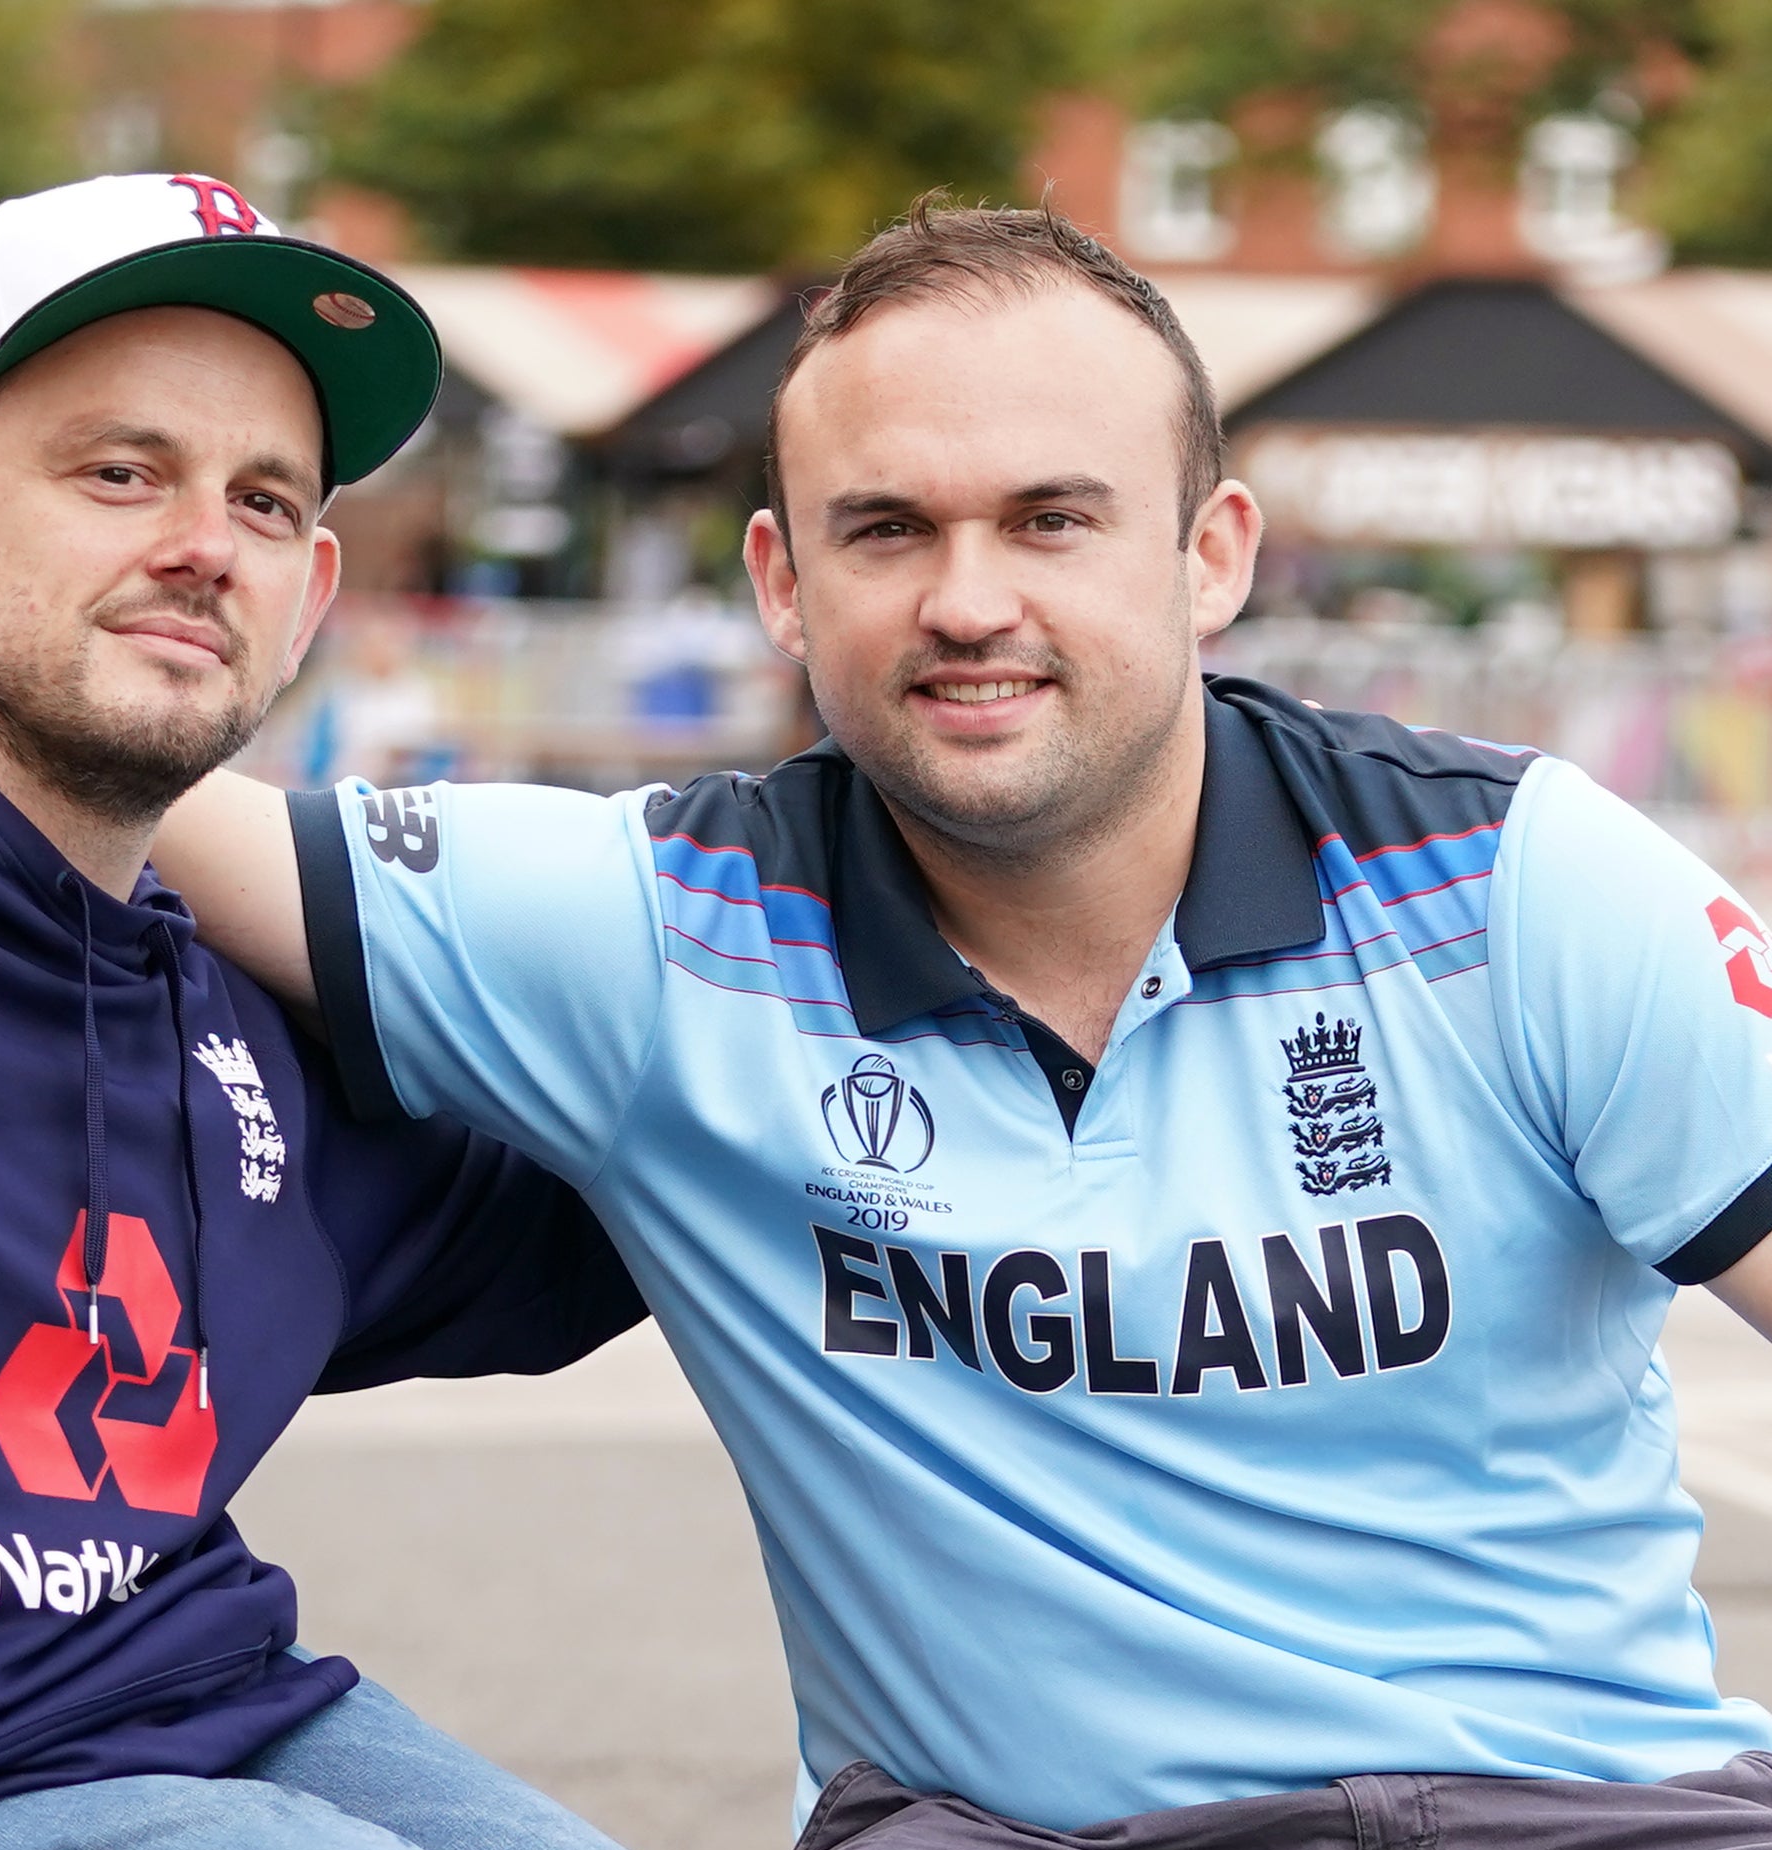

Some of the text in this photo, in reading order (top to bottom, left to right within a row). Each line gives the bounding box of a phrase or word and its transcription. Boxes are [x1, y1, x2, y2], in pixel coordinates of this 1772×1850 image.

[821, 1167, 936, 1191] ICC CRICKET WORLD CUP
[848, 1179, 909, 1195] CHAMPIONS
[805, 1183, 954, 1214] ENGLAND & WALES
[845, 1205, 910, 1232] 2019
[807, 1210, 1454, 1397] ENGLAND
